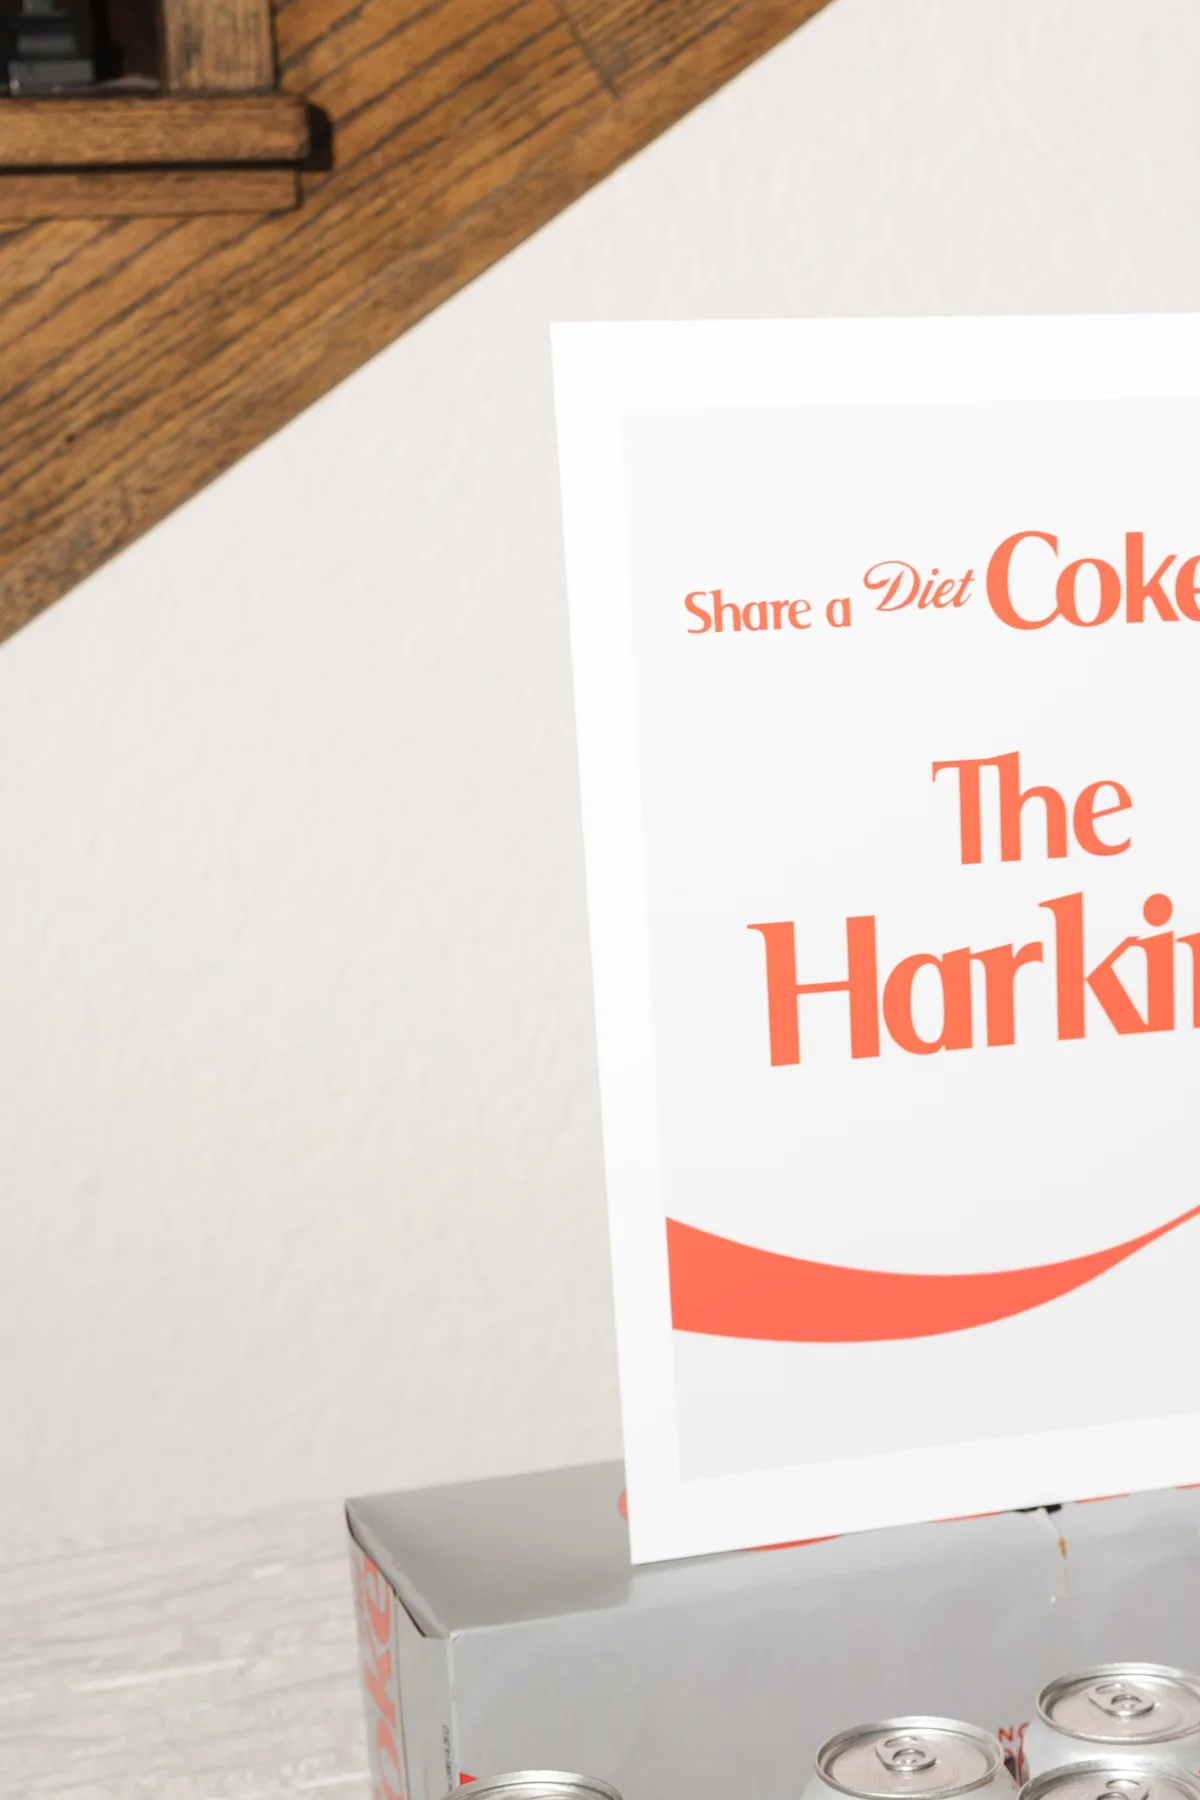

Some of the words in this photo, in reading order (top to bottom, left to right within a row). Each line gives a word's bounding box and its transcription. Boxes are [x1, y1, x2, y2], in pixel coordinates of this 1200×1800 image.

[684, 584, 813, 635] Share
[825, 592, 852, 628] a
[862, 559, 977, 613] Diet
[932, 751, 1133, 865] The
